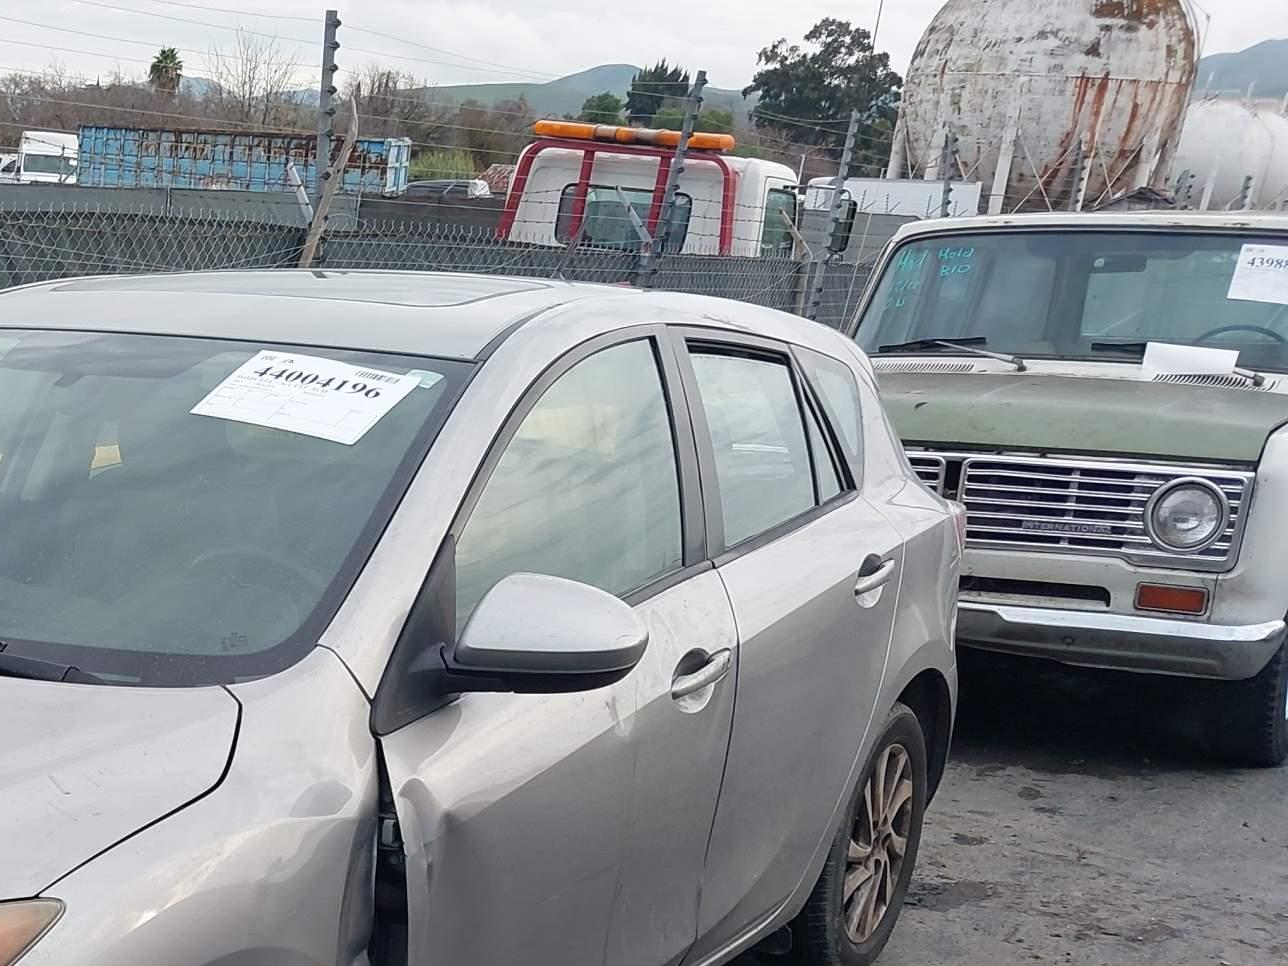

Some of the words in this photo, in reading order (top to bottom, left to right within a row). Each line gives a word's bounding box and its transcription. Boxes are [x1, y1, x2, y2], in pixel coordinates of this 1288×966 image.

[938, 247, 974, 260] Hold
[253, 366, 381, 399] 44004196
[1021, 520, 1112, 534] INTERNATIONAL
